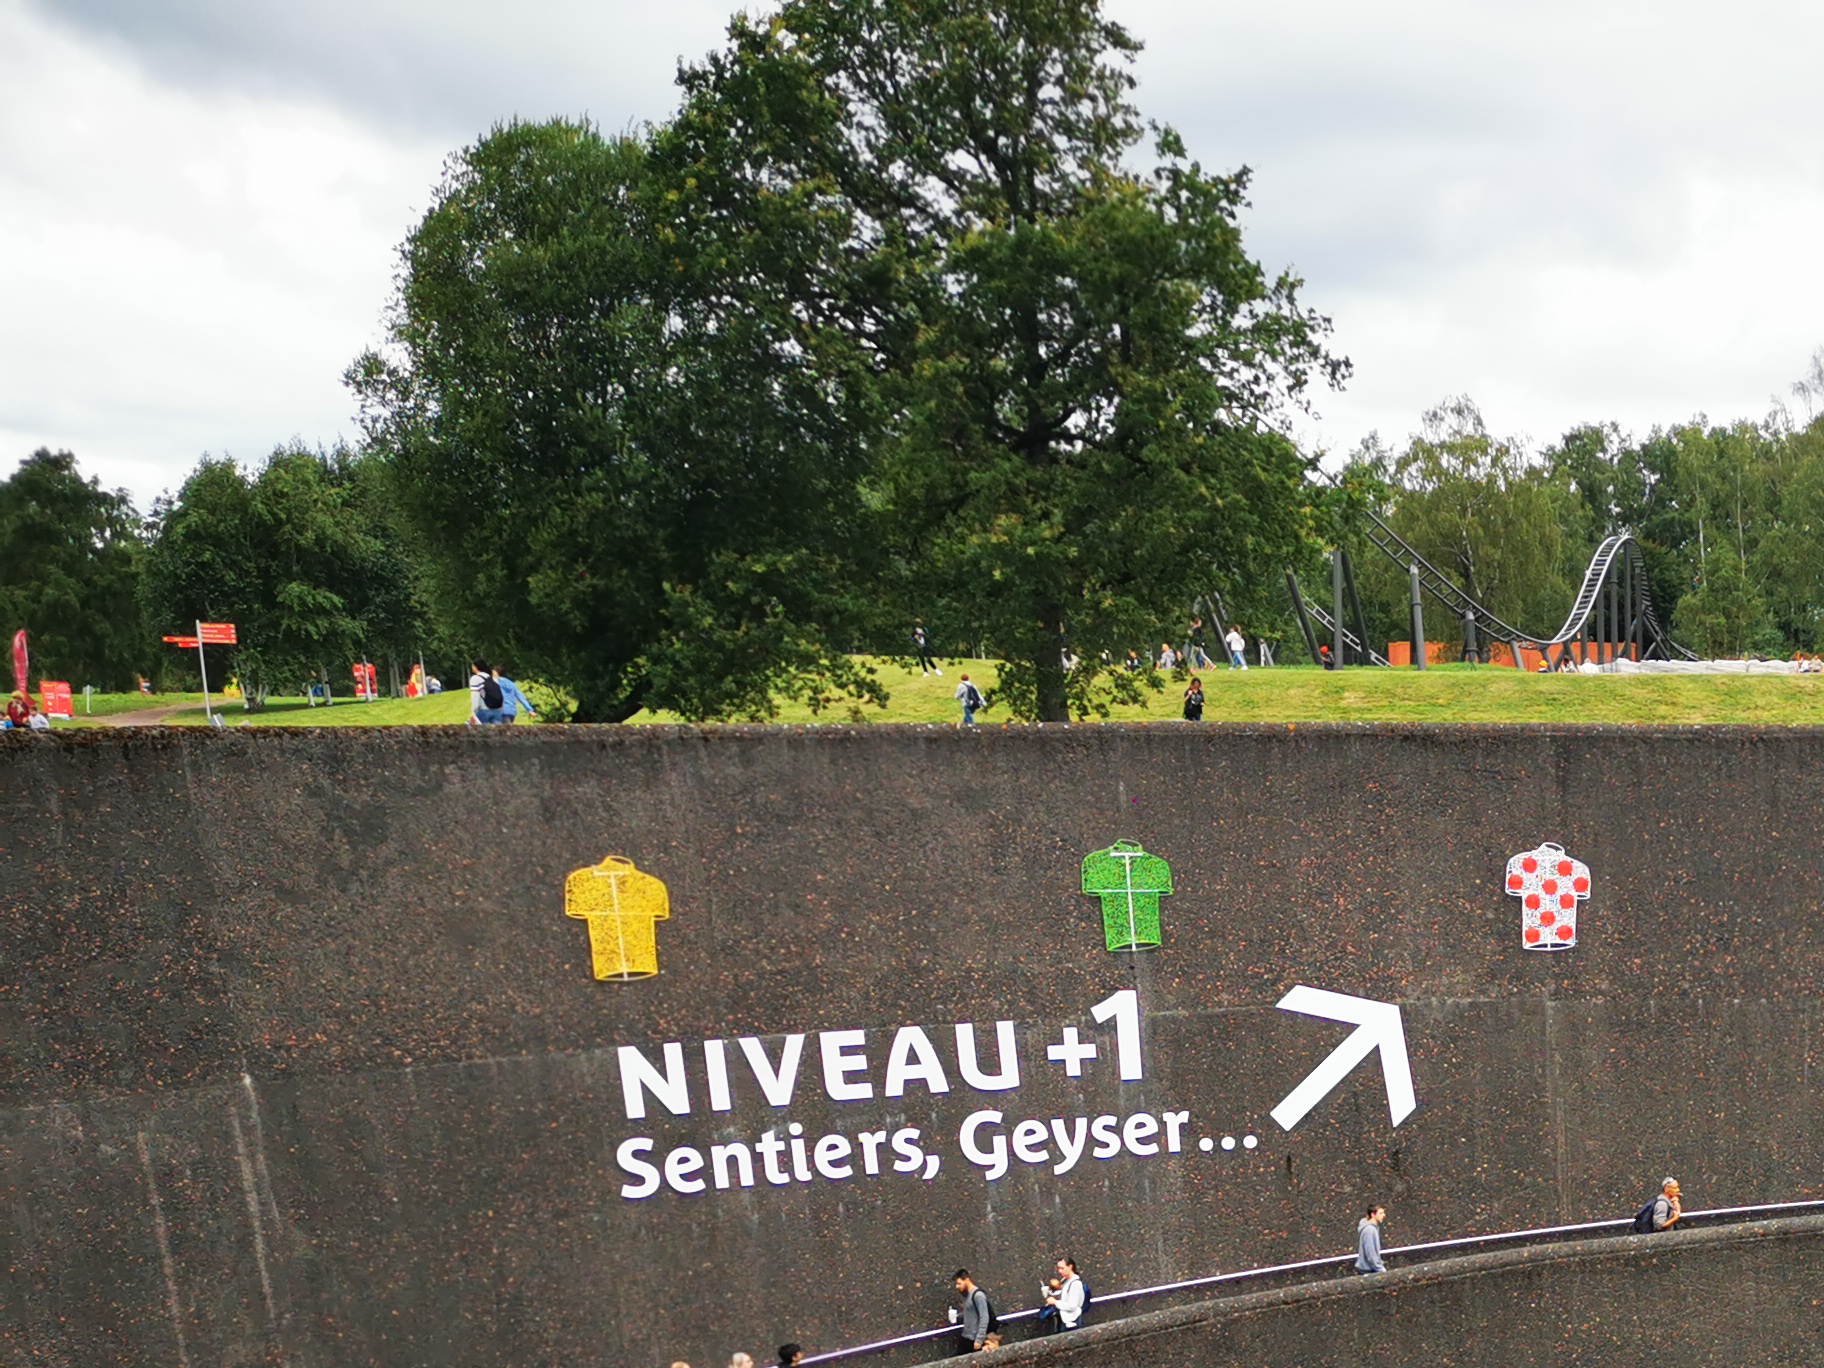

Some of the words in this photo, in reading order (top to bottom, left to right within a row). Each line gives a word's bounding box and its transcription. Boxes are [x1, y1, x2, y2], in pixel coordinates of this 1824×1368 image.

[617, 1020, 1021, 1119] NIVEAU
[1046, 989, 1143, 1081] +1
[616, 1122, 940, 1199] Sentiers,
[959, 1109, 1258, 1181] Geyser...
